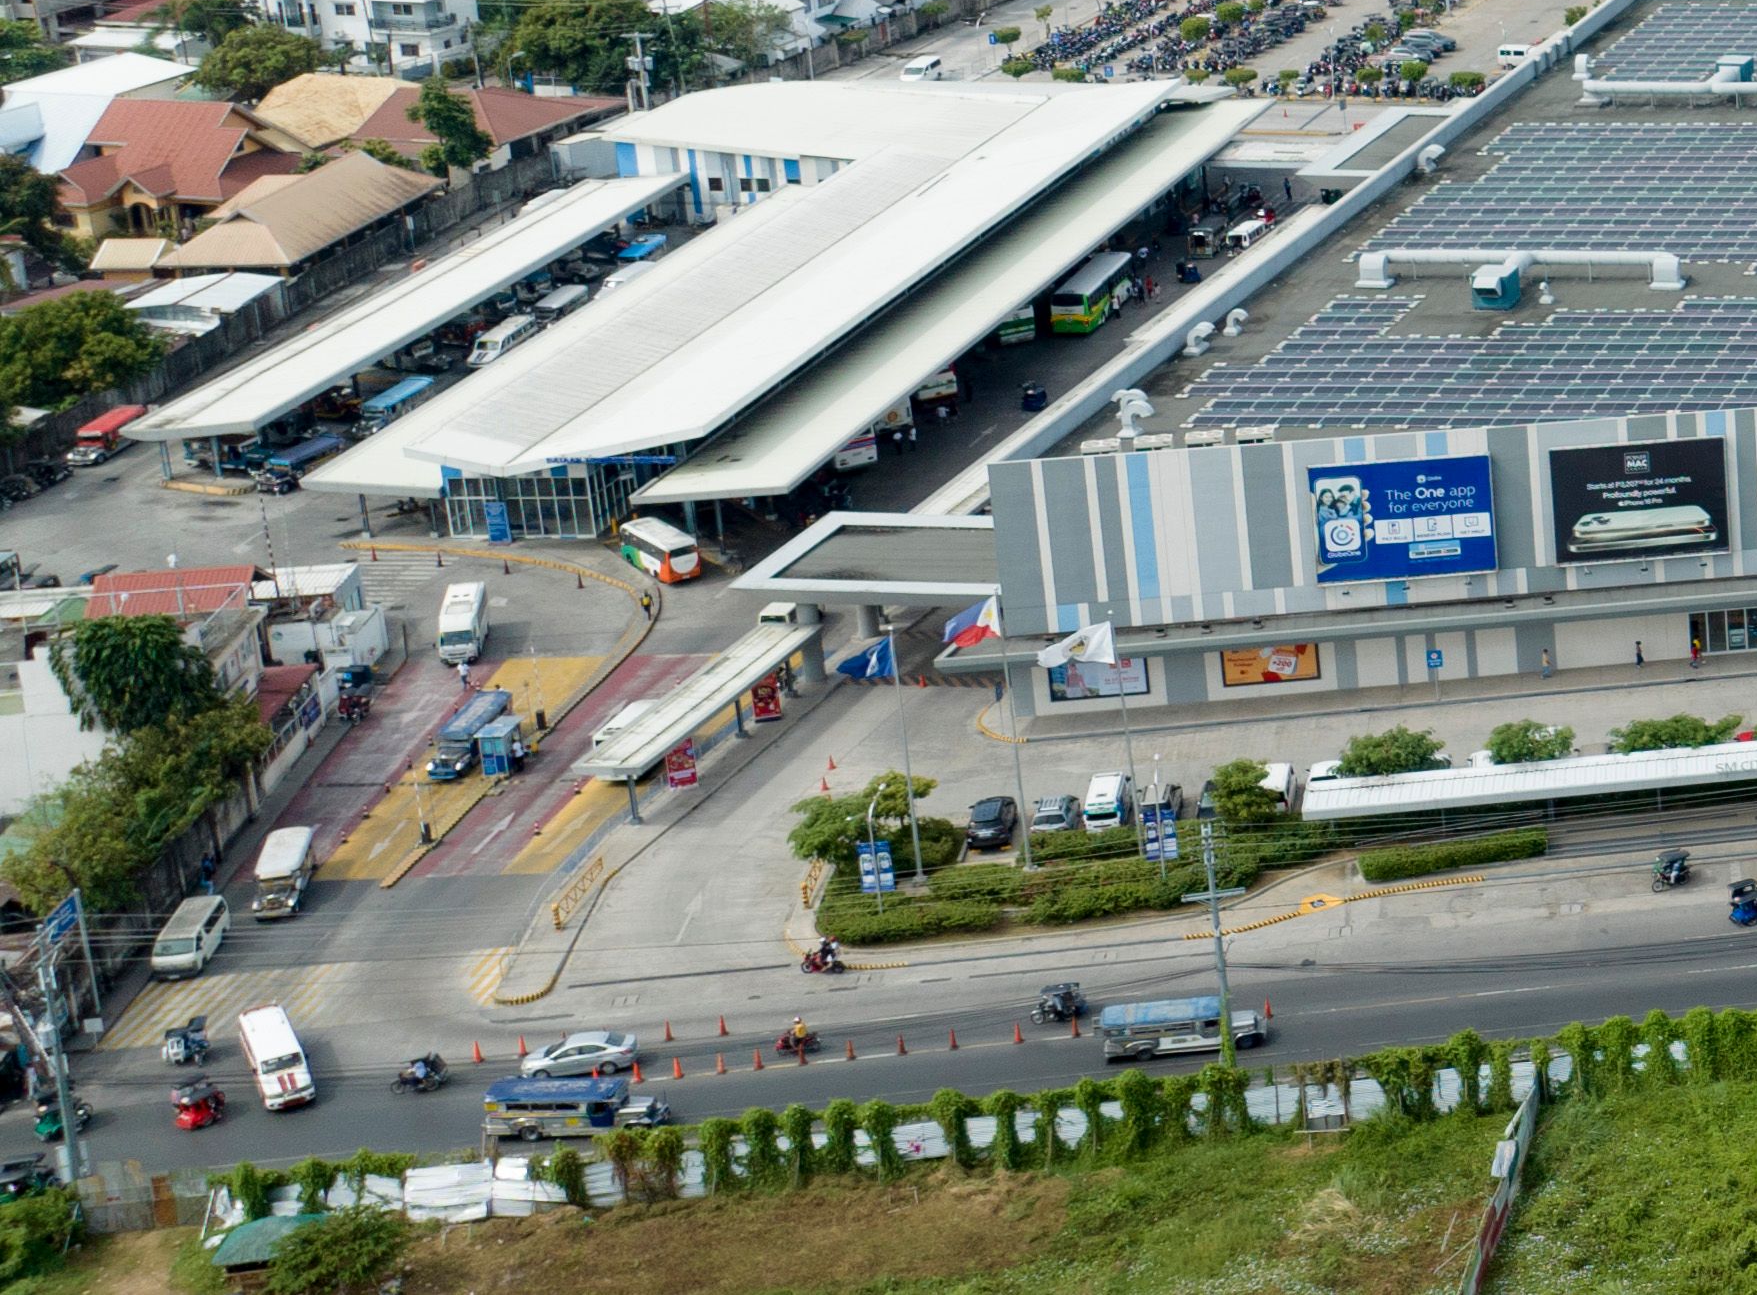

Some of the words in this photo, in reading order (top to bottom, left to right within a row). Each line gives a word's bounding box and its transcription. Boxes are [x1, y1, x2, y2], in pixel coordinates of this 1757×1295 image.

[1384, 489, 1412, 500] The
[1415, 487, 1445, 499] One
[1449, 485, 1476, 498] app
[1388, 502, 1408, 514] for
[1412, 499, 1474, 513] everyone
